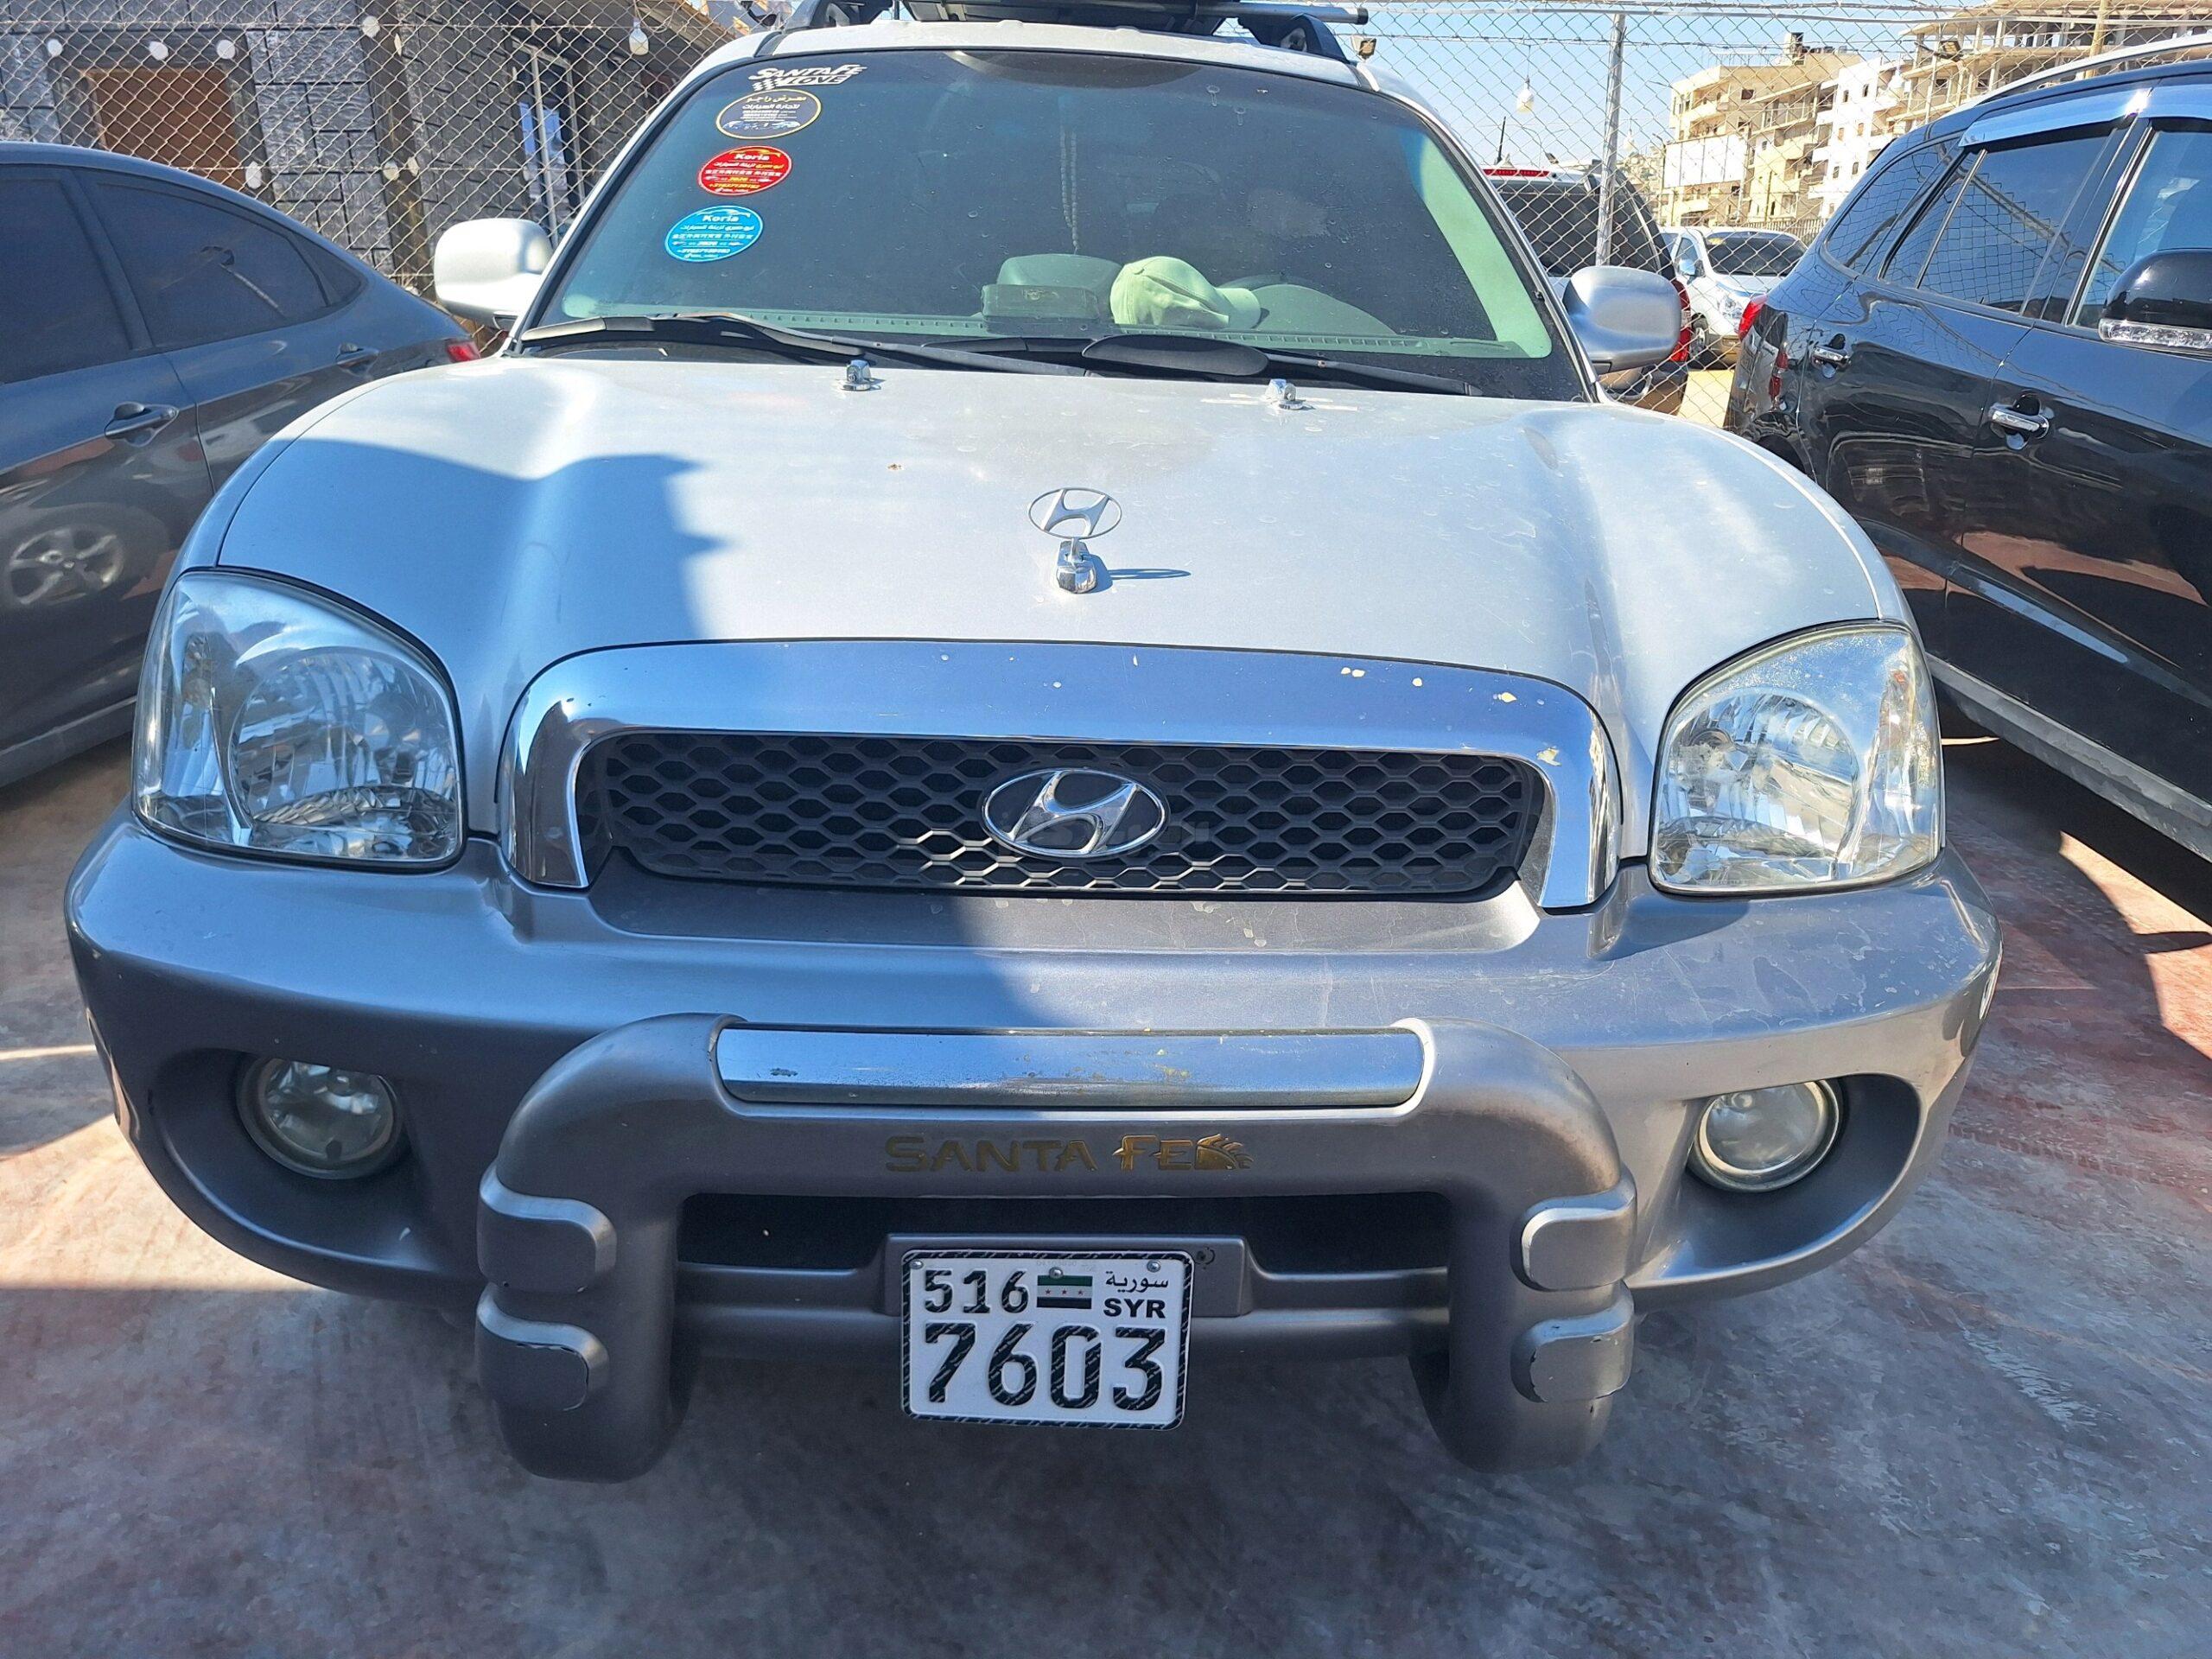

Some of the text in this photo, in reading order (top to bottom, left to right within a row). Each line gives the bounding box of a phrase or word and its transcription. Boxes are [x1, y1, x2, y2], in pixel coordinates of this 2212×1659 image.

[885, 1135, 1194, 1173] SANTA FE
[924, 1269, 1030, 1314] 516
[1105, 1271, 1169, 1293] سورية
[1103, 1298, 1166, 1319] SYR
[924, 1322, 1167, 1411] 7603
